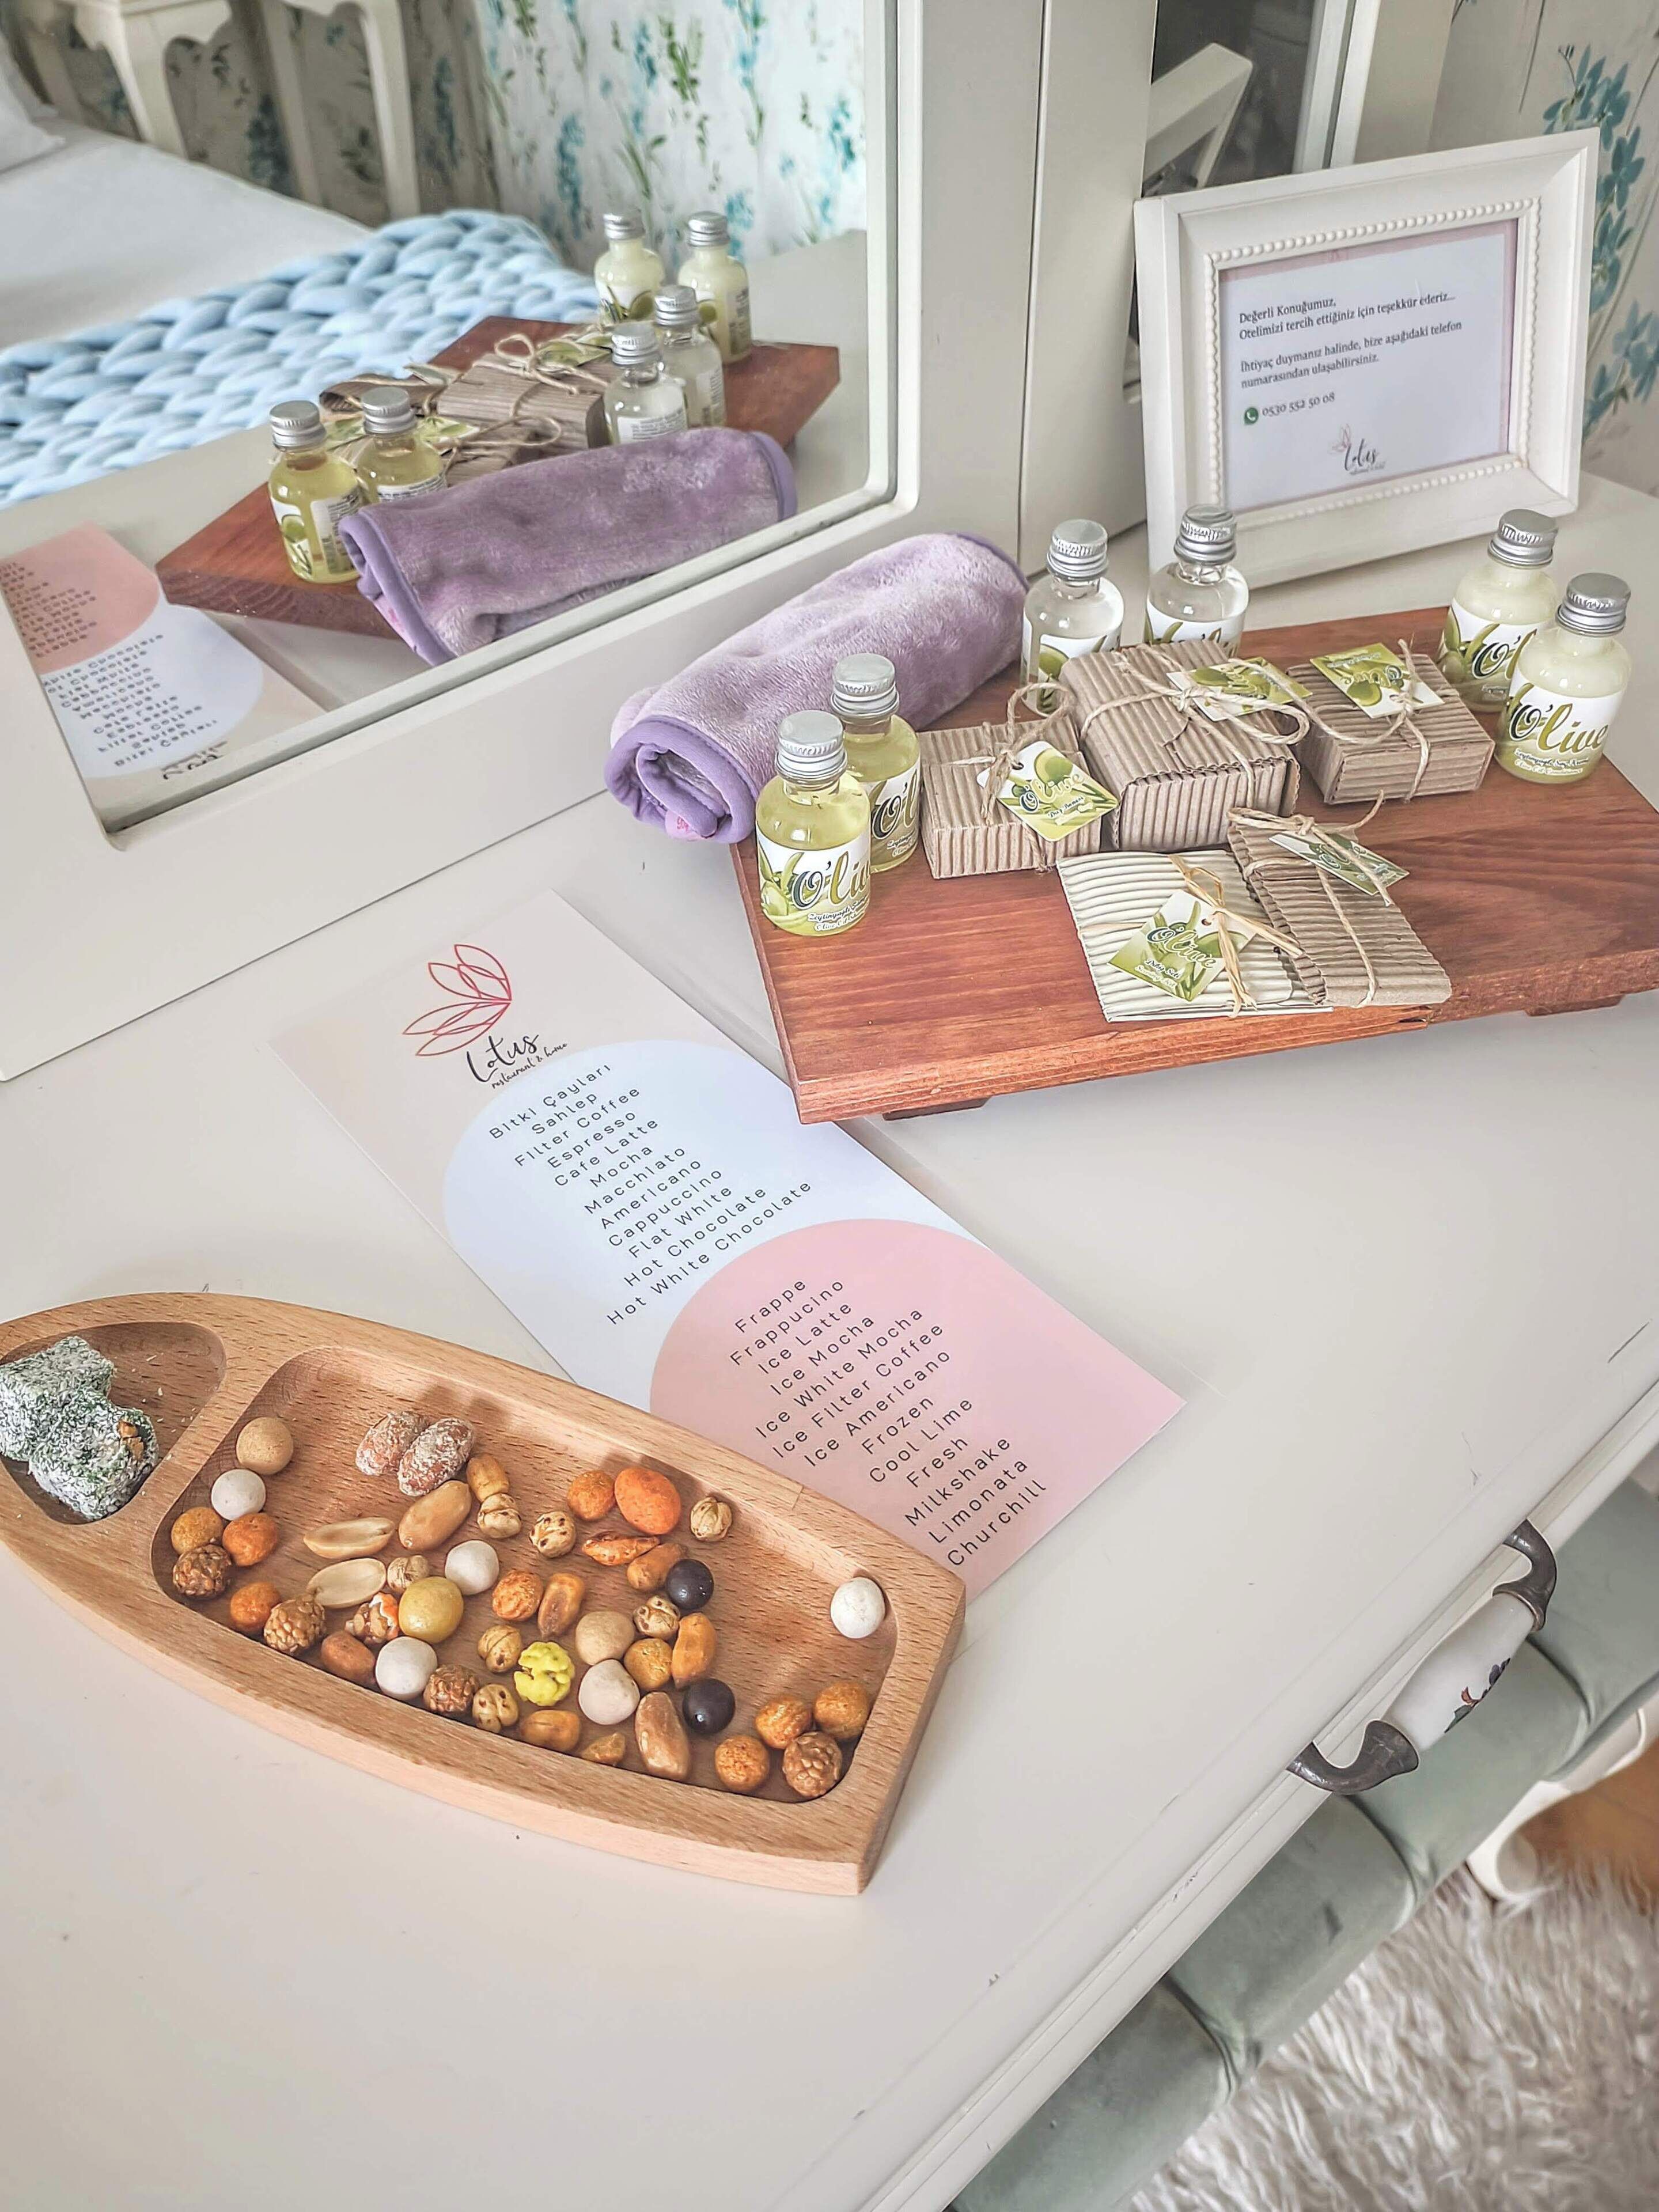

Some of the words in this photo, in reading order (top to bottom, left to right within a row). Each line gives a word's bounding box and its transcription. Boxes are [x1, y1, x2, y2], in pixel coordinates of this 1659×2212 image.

[1239, 306, 1274, 324] Değerli
[1239, 321, 1283, 340] Otelimizi
[1286, 316, 1314, 331] tercih
[1316, 307, 1355, 325] ettiğiniz
[1357, 305, 1375, 319] için
[1377, 298, 1418, 315] teşekkür
[1275, 349, 1323, 368] duymanız
[1363, 336, 1383, 349] bize
[1385, 325, 1429, 345] aşağıdaki
[1430, 320, 1462, 336] telefon
[1241, 368, 1310, 389] numarasından
[466, 1034, 540, 1083] Lotus
[488, 1107, 537, 1139] Bitki
[543, 1065, 611, 1108] Çayları
[514, 1130, 569, 1167] Filter
[577, 1089, 639, 1128] Coffee
[531, 1094, 597, 1134] Sahlep
[547, 1112, 636, 1168] Espresso
[554, 1157, 600, 1186] Cafe
[604, 1120, 658, 1154] Latte
[589, 1147, 653, 1188] Mocha
[584, 1148, 685, 1214] Macchiato
[601, 1161, 701, 1230] Americano
[608, 1171, 722, 1247] Cappuccino
[606, 1297, 647, 1325] Hot
[650, 1254, 710, 1294] White
[714, 1183, 811, 1251] Chocolate
[623, 1259, 664, 1287] Hot
[668, 1189, 766, 1257] Chocolate
[628, 1228, 672, 1259] Flat
[674, 1188, 732, 1226] White
[729, 1282, 843, 1366] Frappucino
[734, 1281, 806, 1334] Frappe
[757, 1349, 792, 1374] Ice
[795, 1304, 851, 1346] Latte
[755, 1411, 791, 1438] Ice
[793, 1362, 854, 1407] White
[857, 1310, 923, 1359] Mocha
[770, 1369, 805, 1396] Ice
[808, 1317, 874, 1367] Mocha
[772, 1431, 808, 1459] Ice
[810, 1380, 870, 1428] Filter
[876, 1325, 943, 1377] Coffee
[804, 1439, 839, 1467] Ice
[846, 1352, 950, 1437] Americano
[861, 1398, 934, 1455] Frozen
[869, 1441, 920, 1483] Cool
[920, 1400, 972, 1441] Lime
[906, 1439, 968, 1488] Fresh
[904, 1439, 1010, 1527] Milkshake
[928, 1461, 1028, 1544] Limonata
[948, 1479, 1047, 1566] Churchill
